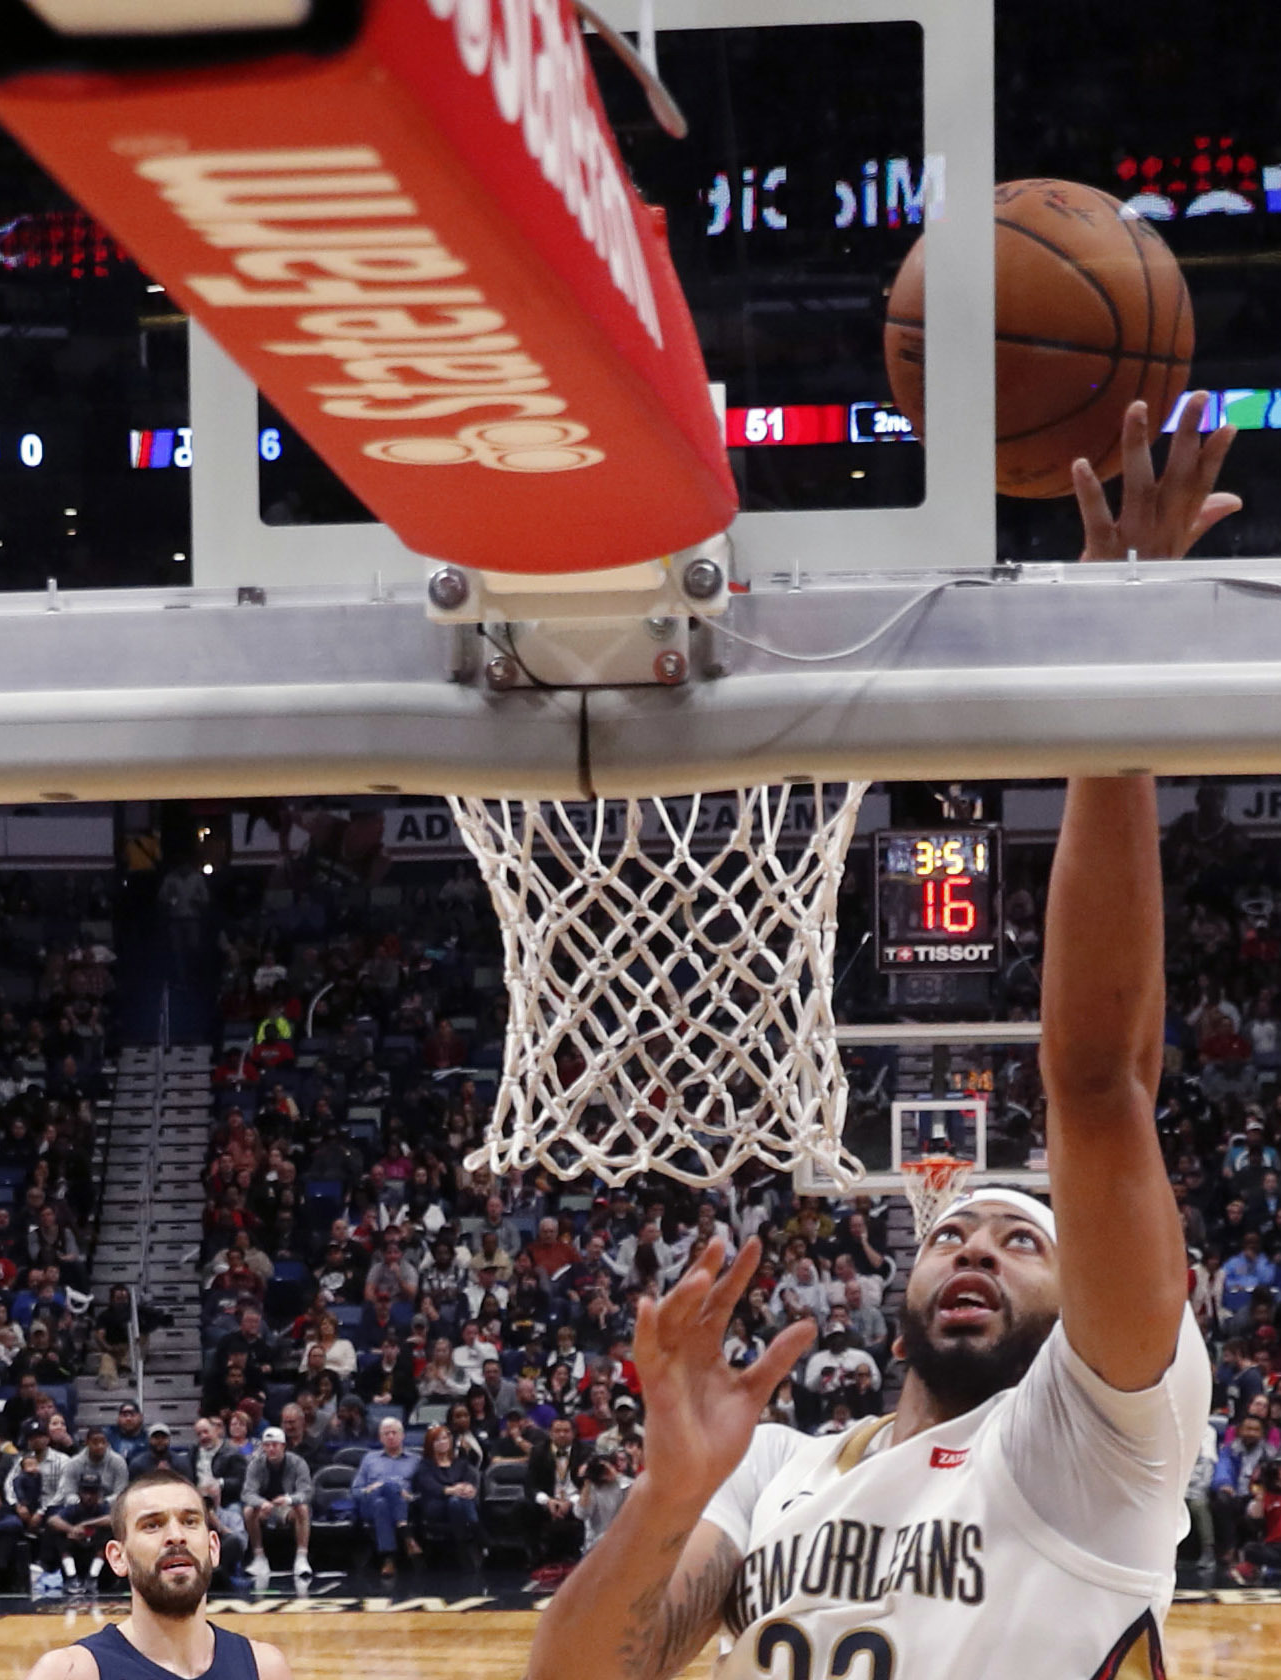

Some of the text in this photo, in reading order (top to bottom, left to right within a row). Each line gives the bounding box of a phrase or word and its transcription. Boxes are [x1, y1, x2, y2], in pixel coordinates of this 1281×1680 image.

[745, 406, 784, 442] 51
[20, 433, 43, 468] 0
[260, 429, 282, 461] 6
[915, 840, 985, 876] 3:51
[923, 875, 976, 934] 16
[914, 944, 994, 962] TISSOT
[800, 1518, 986, 1607] ORLEANS
